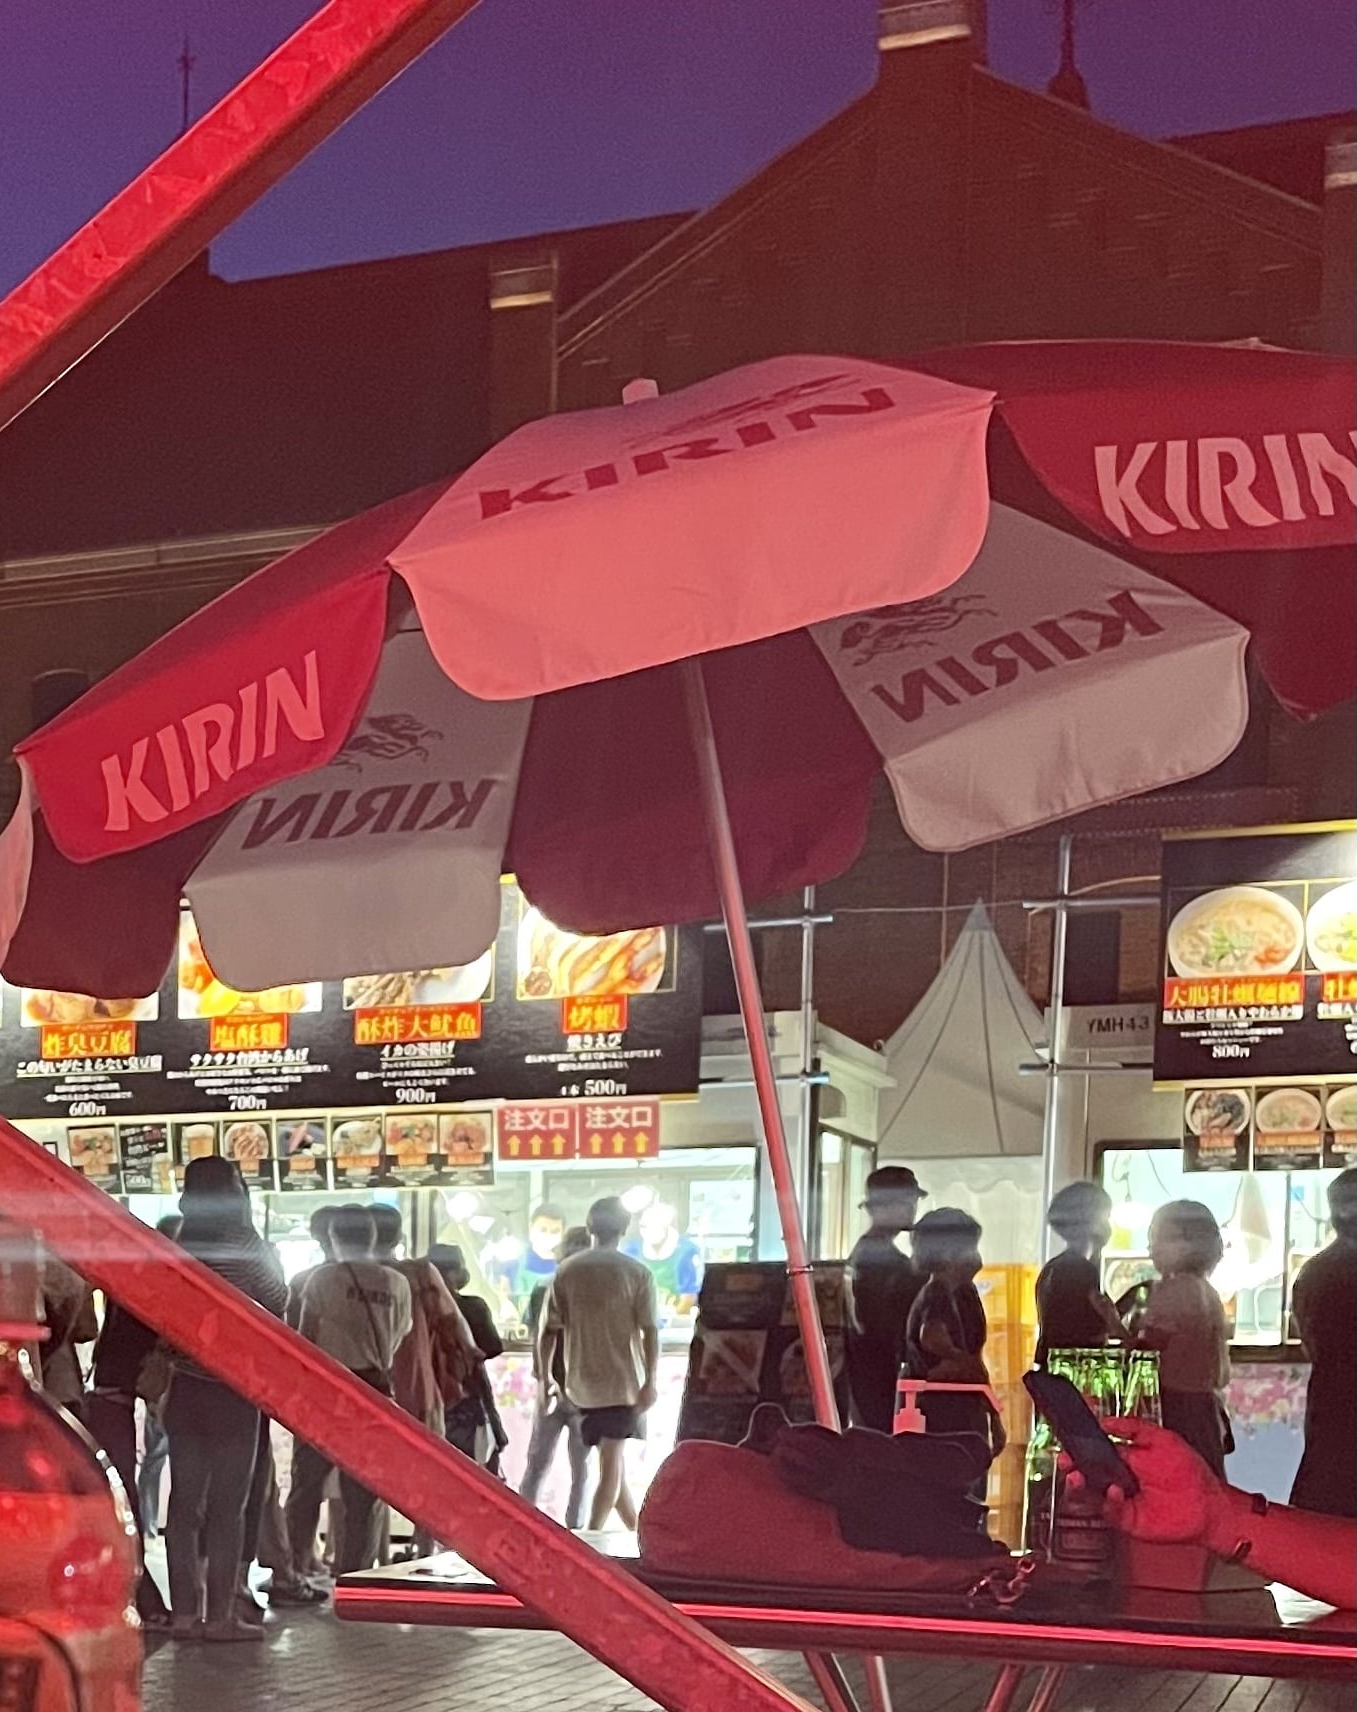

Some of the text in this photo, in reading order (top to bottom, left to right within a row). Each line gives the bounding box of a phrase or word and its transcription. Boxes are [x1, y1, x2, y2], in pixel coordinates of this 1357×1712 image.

[478, 387, 896, 520] KIRIN
[1094, 431, 1357, 538] KIRIN
[100, 650, 324, 832] KIRIN
[395, 1087, 436, 1104] 900円
[584, 1079, 628, 1096] 500円
[68, 1102, 107, 1117] 600円
[228, 1095, 267, 1111] 700円
[504, 1107, 570, 1131] 注文口
[585, 1106, 652, 1129] 注文口
